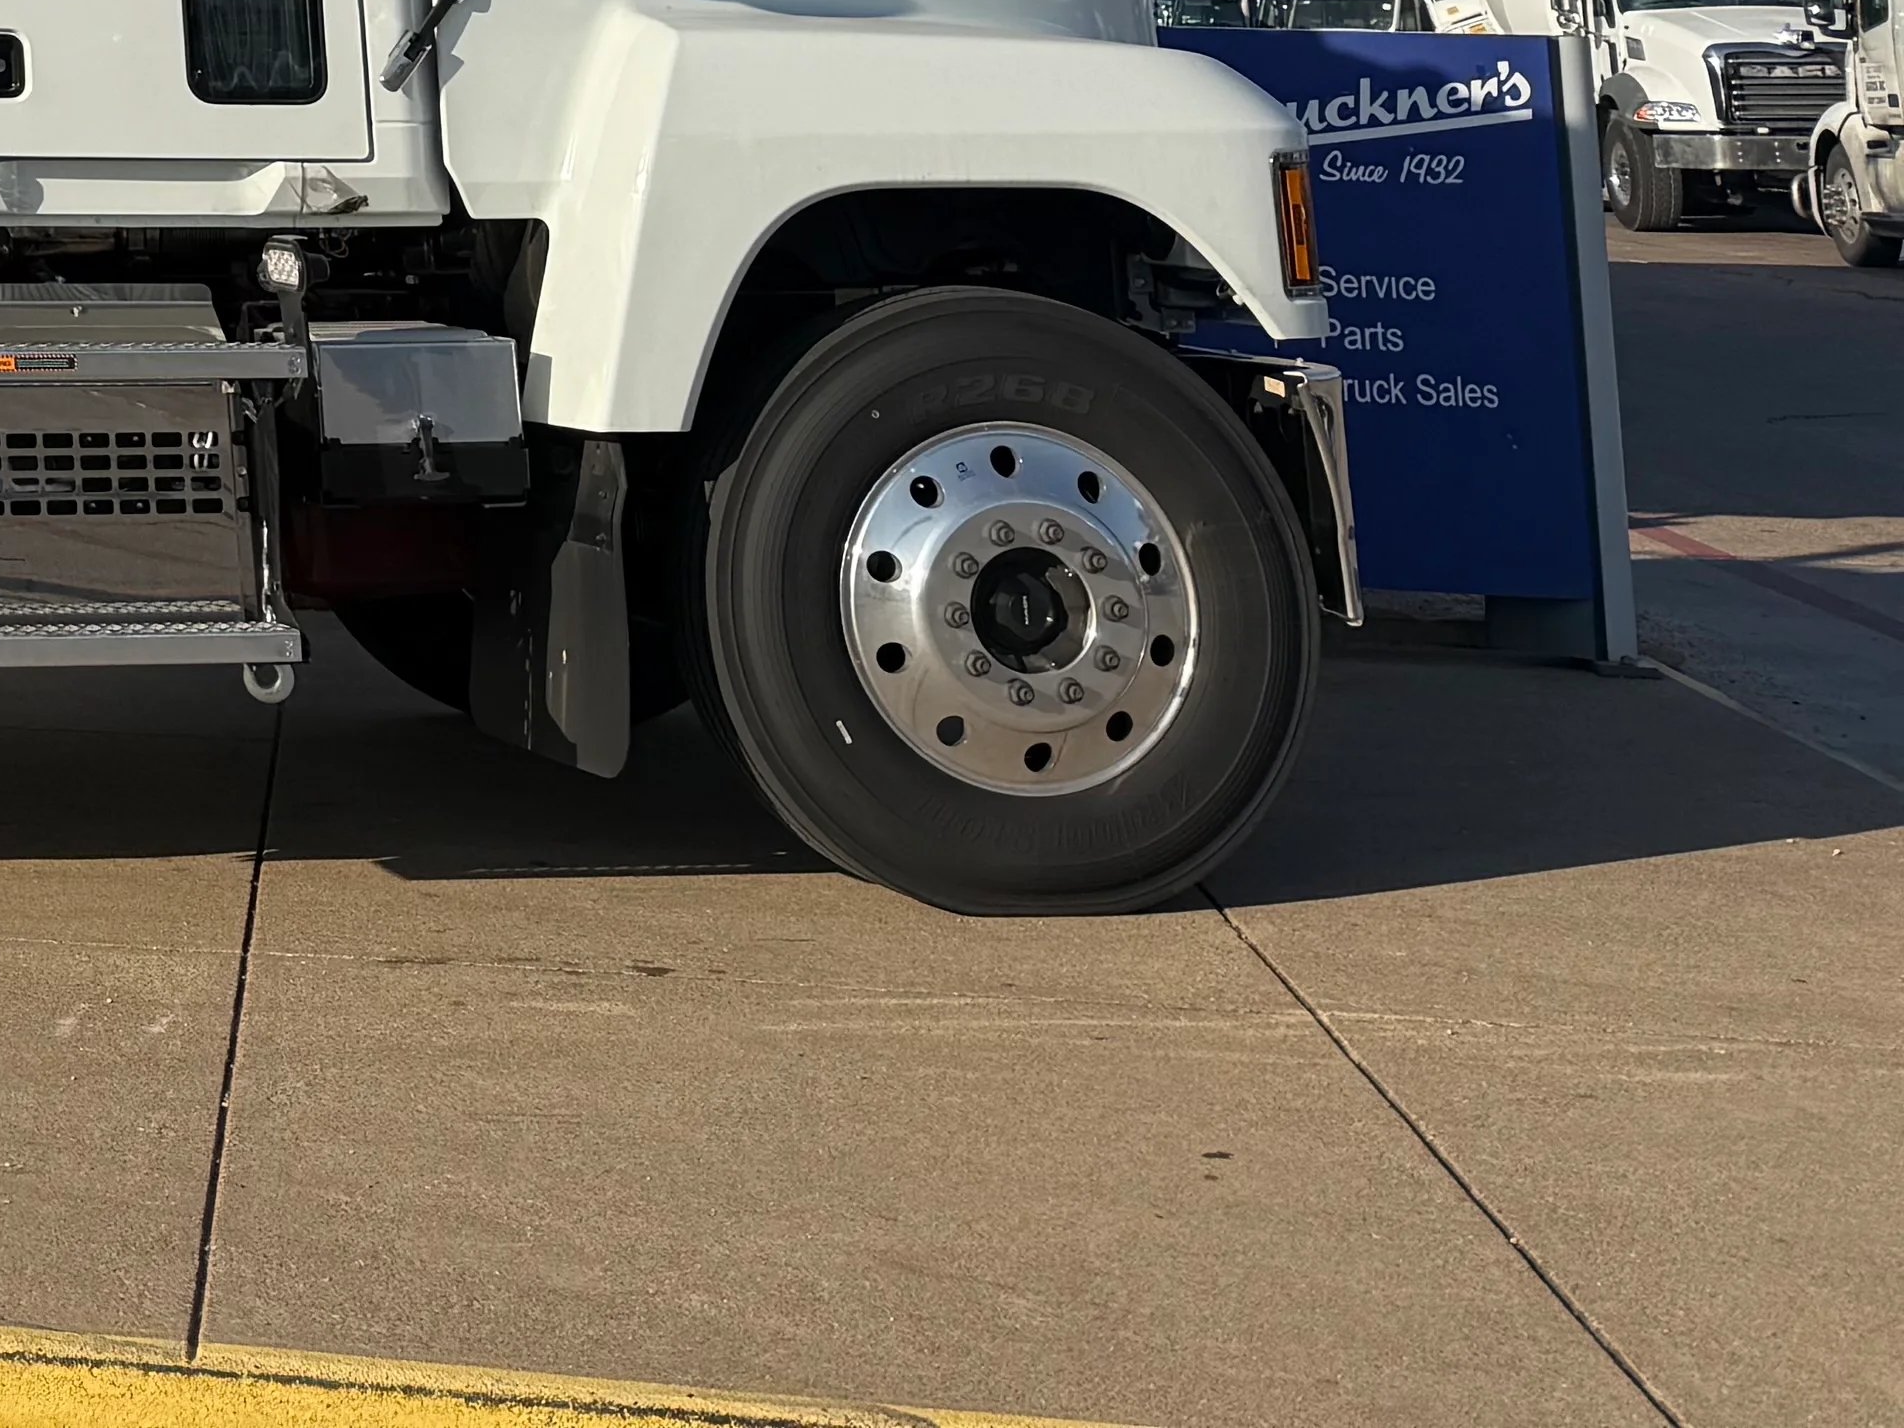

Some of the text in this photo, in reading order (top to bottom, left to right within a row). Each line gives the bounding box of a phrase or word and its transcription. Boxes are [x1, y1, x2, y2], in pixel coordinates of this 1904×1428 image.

[1284, 60, 1532, 132] uckner's
[1319, 150, 1466, 185] Since 1932
[1317, 265, 1437, 301] Service
[1320, 318, 1405, 353] Parts
[907, 372, 1097, 425] R268
[1343, 372, 1500, 409] ruck Sales
